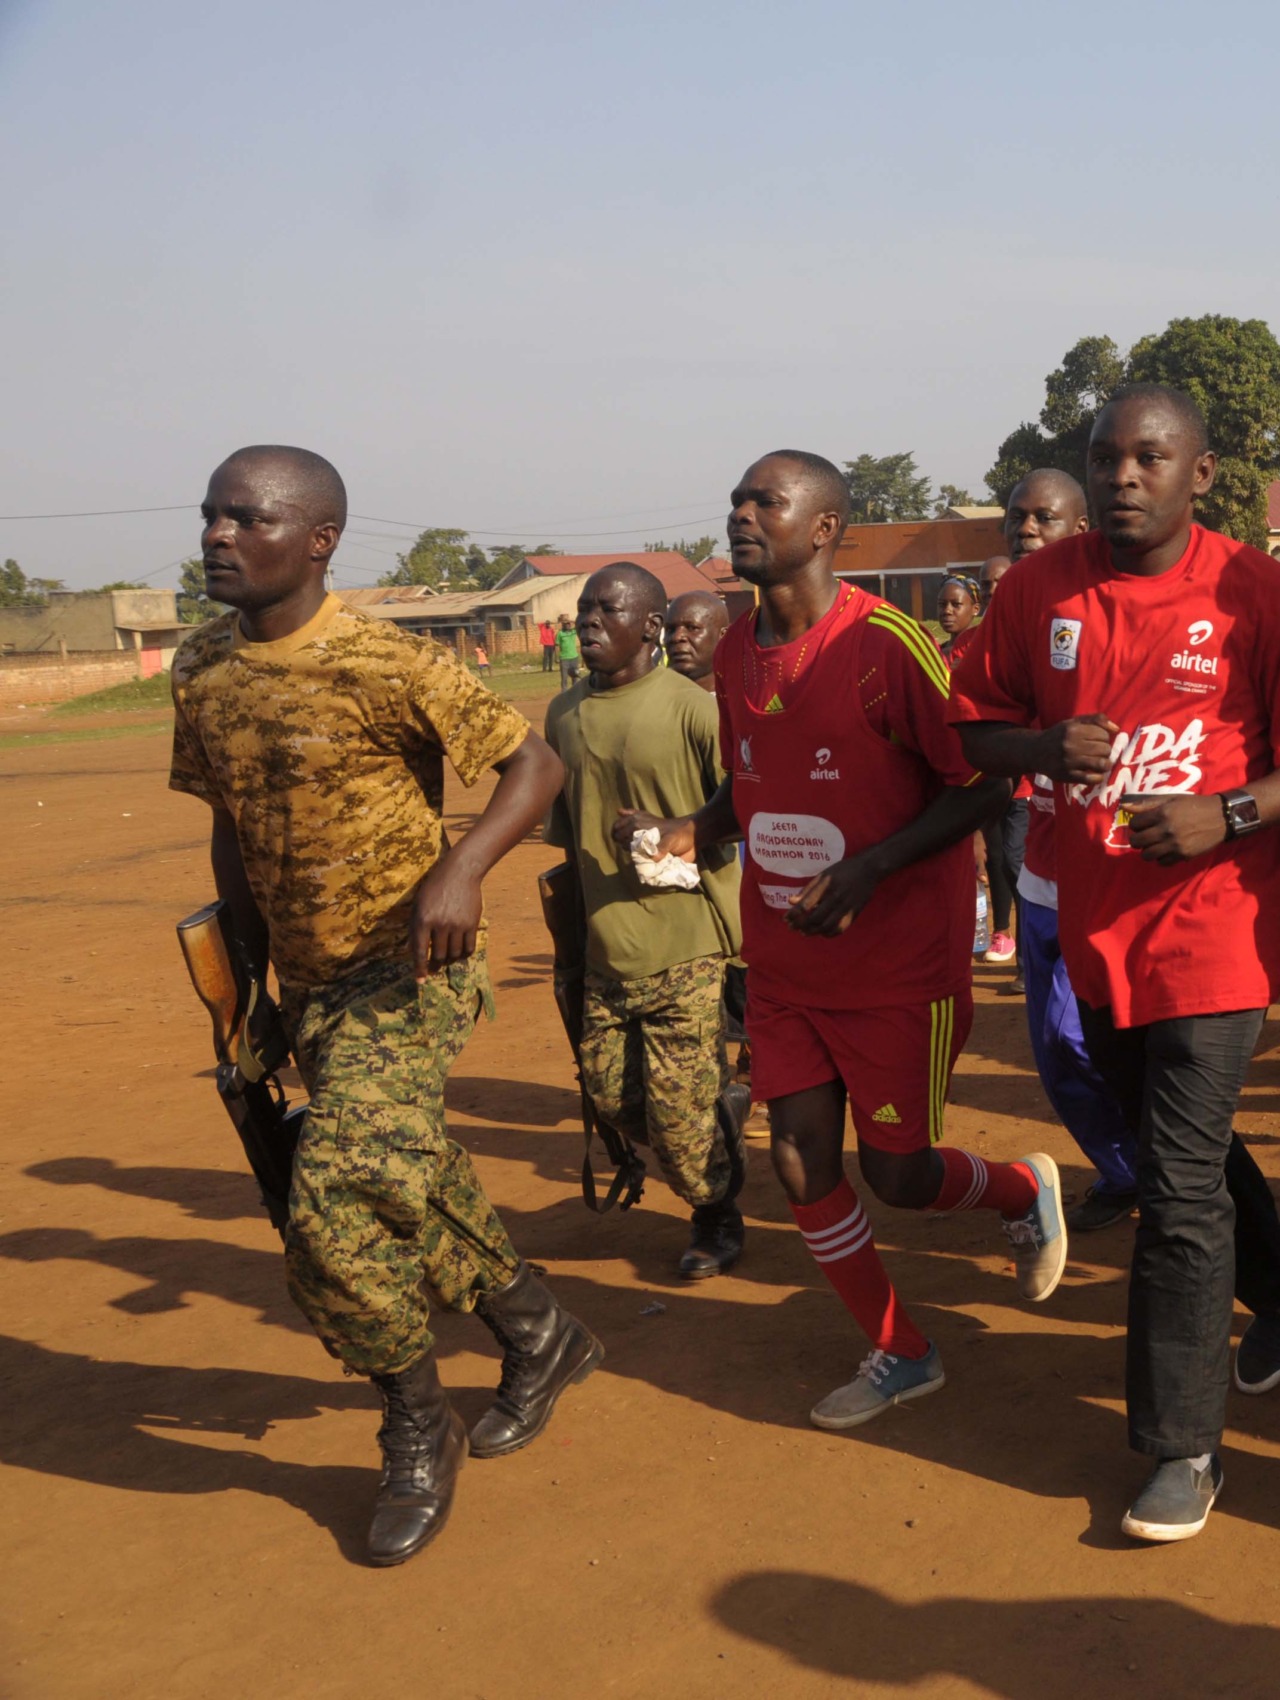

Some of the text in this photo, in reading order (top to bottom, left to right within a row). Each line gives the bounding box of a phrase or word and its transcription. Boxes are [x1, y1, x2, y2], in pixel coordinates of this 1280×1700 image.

[1170, 649, 1218, 675] airtel
[1109, 718, 1209, 766] NDA
[810, 767, 840, 780] airtel
[771, 821, 798, 832] SEETA
[756, 832, 824, 847] ARCHDEACONRY
[755, 847, 831, 862] MARATHON 2016
[775, 892, 787, 902] The
